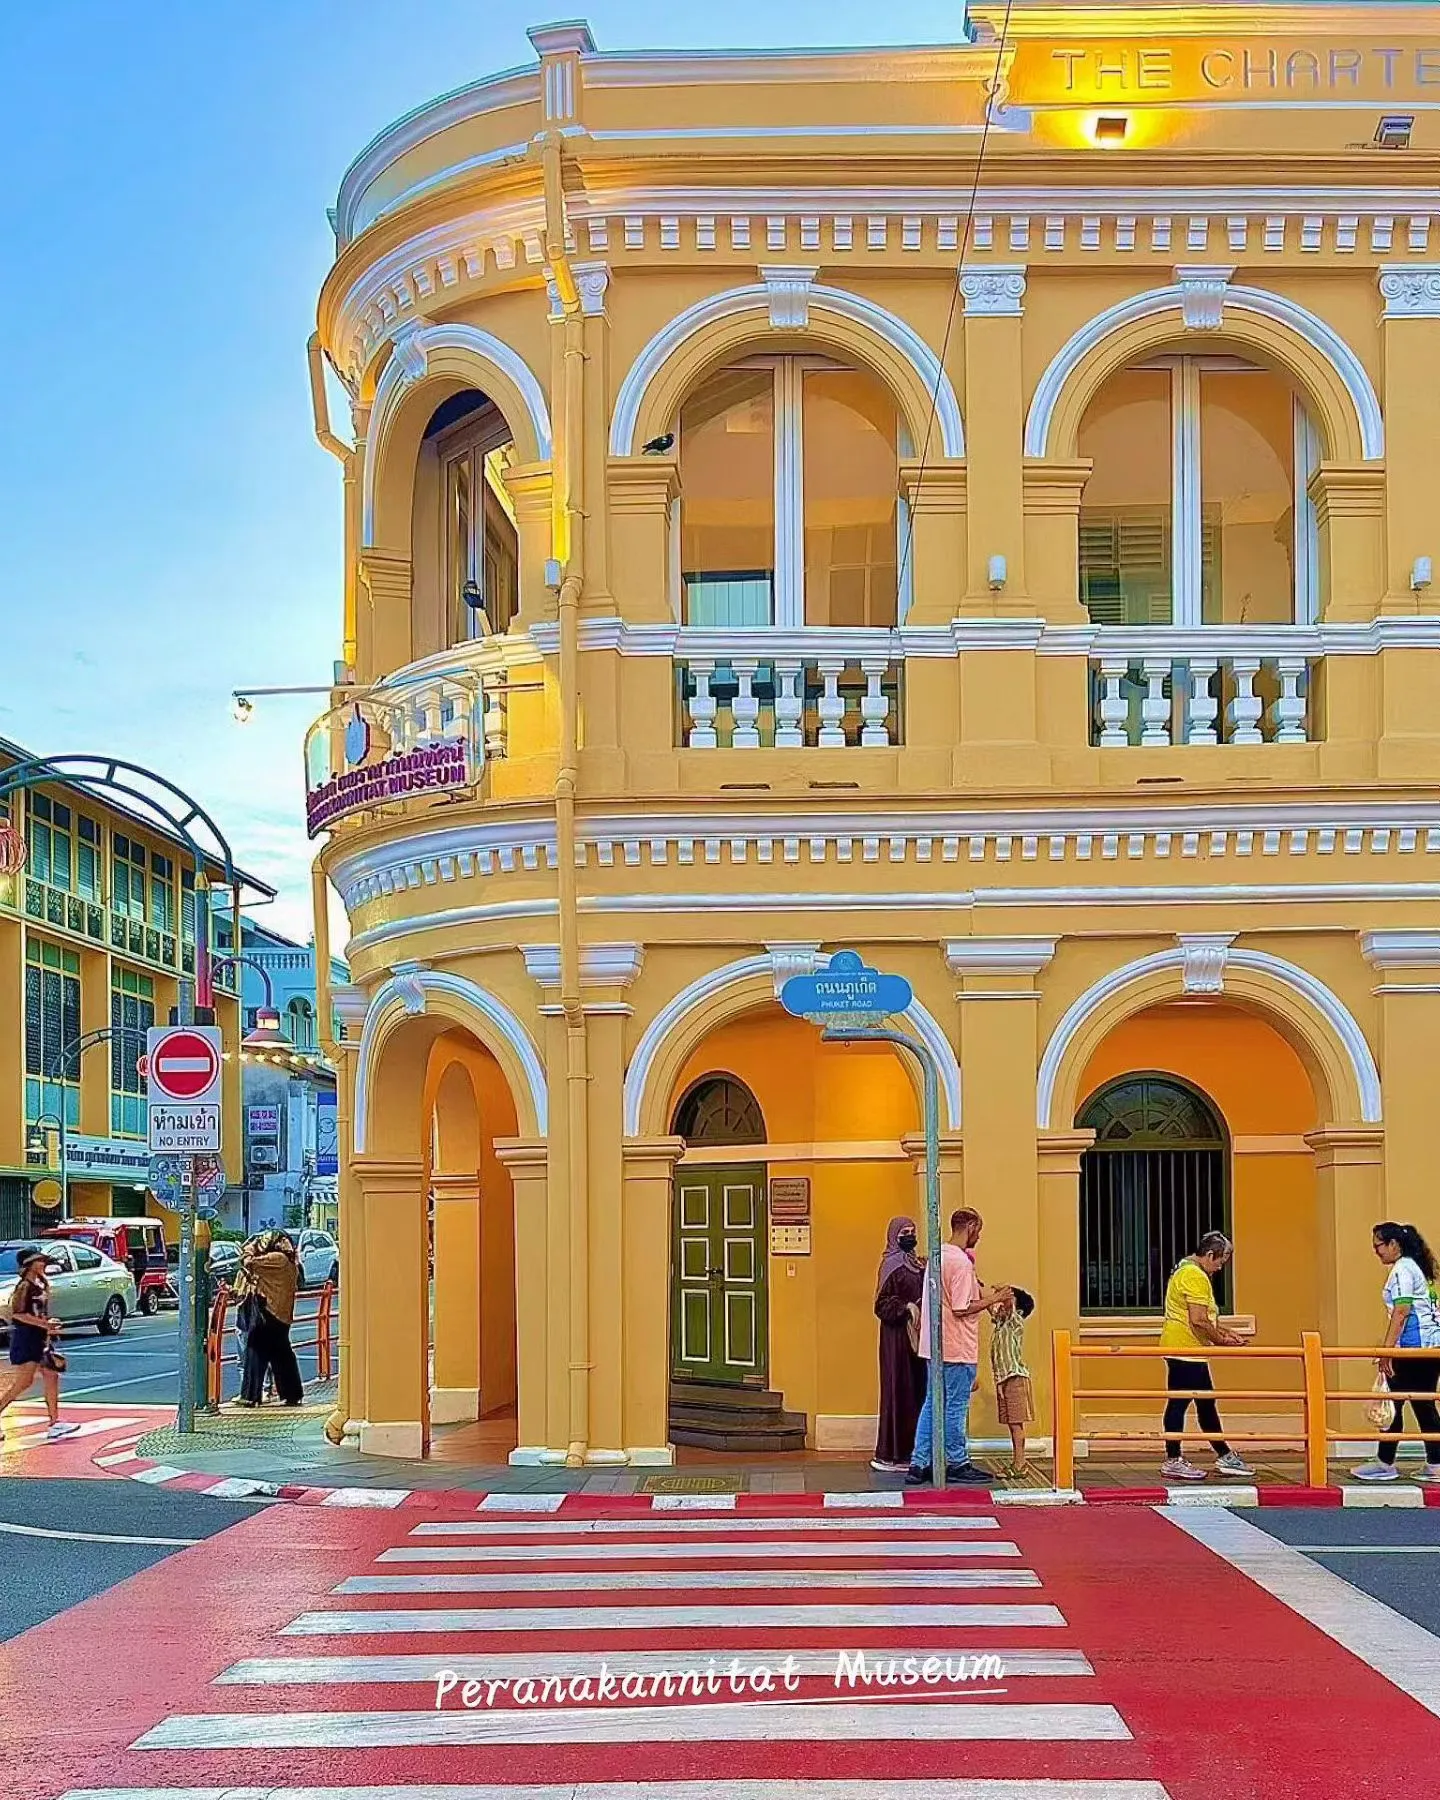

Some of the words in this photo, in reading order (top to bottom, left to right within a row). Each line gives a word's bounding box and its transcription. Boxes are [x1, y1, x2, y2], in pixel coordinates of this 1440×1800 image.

[1051, 48, 1172, 90] THE
[389, 764, 466, 794] MUSEUM
[815, 976, 877, 1000] ถนนภูเก็ต
[821, 1000, 849, 1009] PHUKET
[852, 1000, 873, 1008] ROAD
[153, 1107, 216, 1130] ห้ามเข้า
[158, 1136, 174, 1147] NO
[177, 1136, 210, 1147] ENTRY
